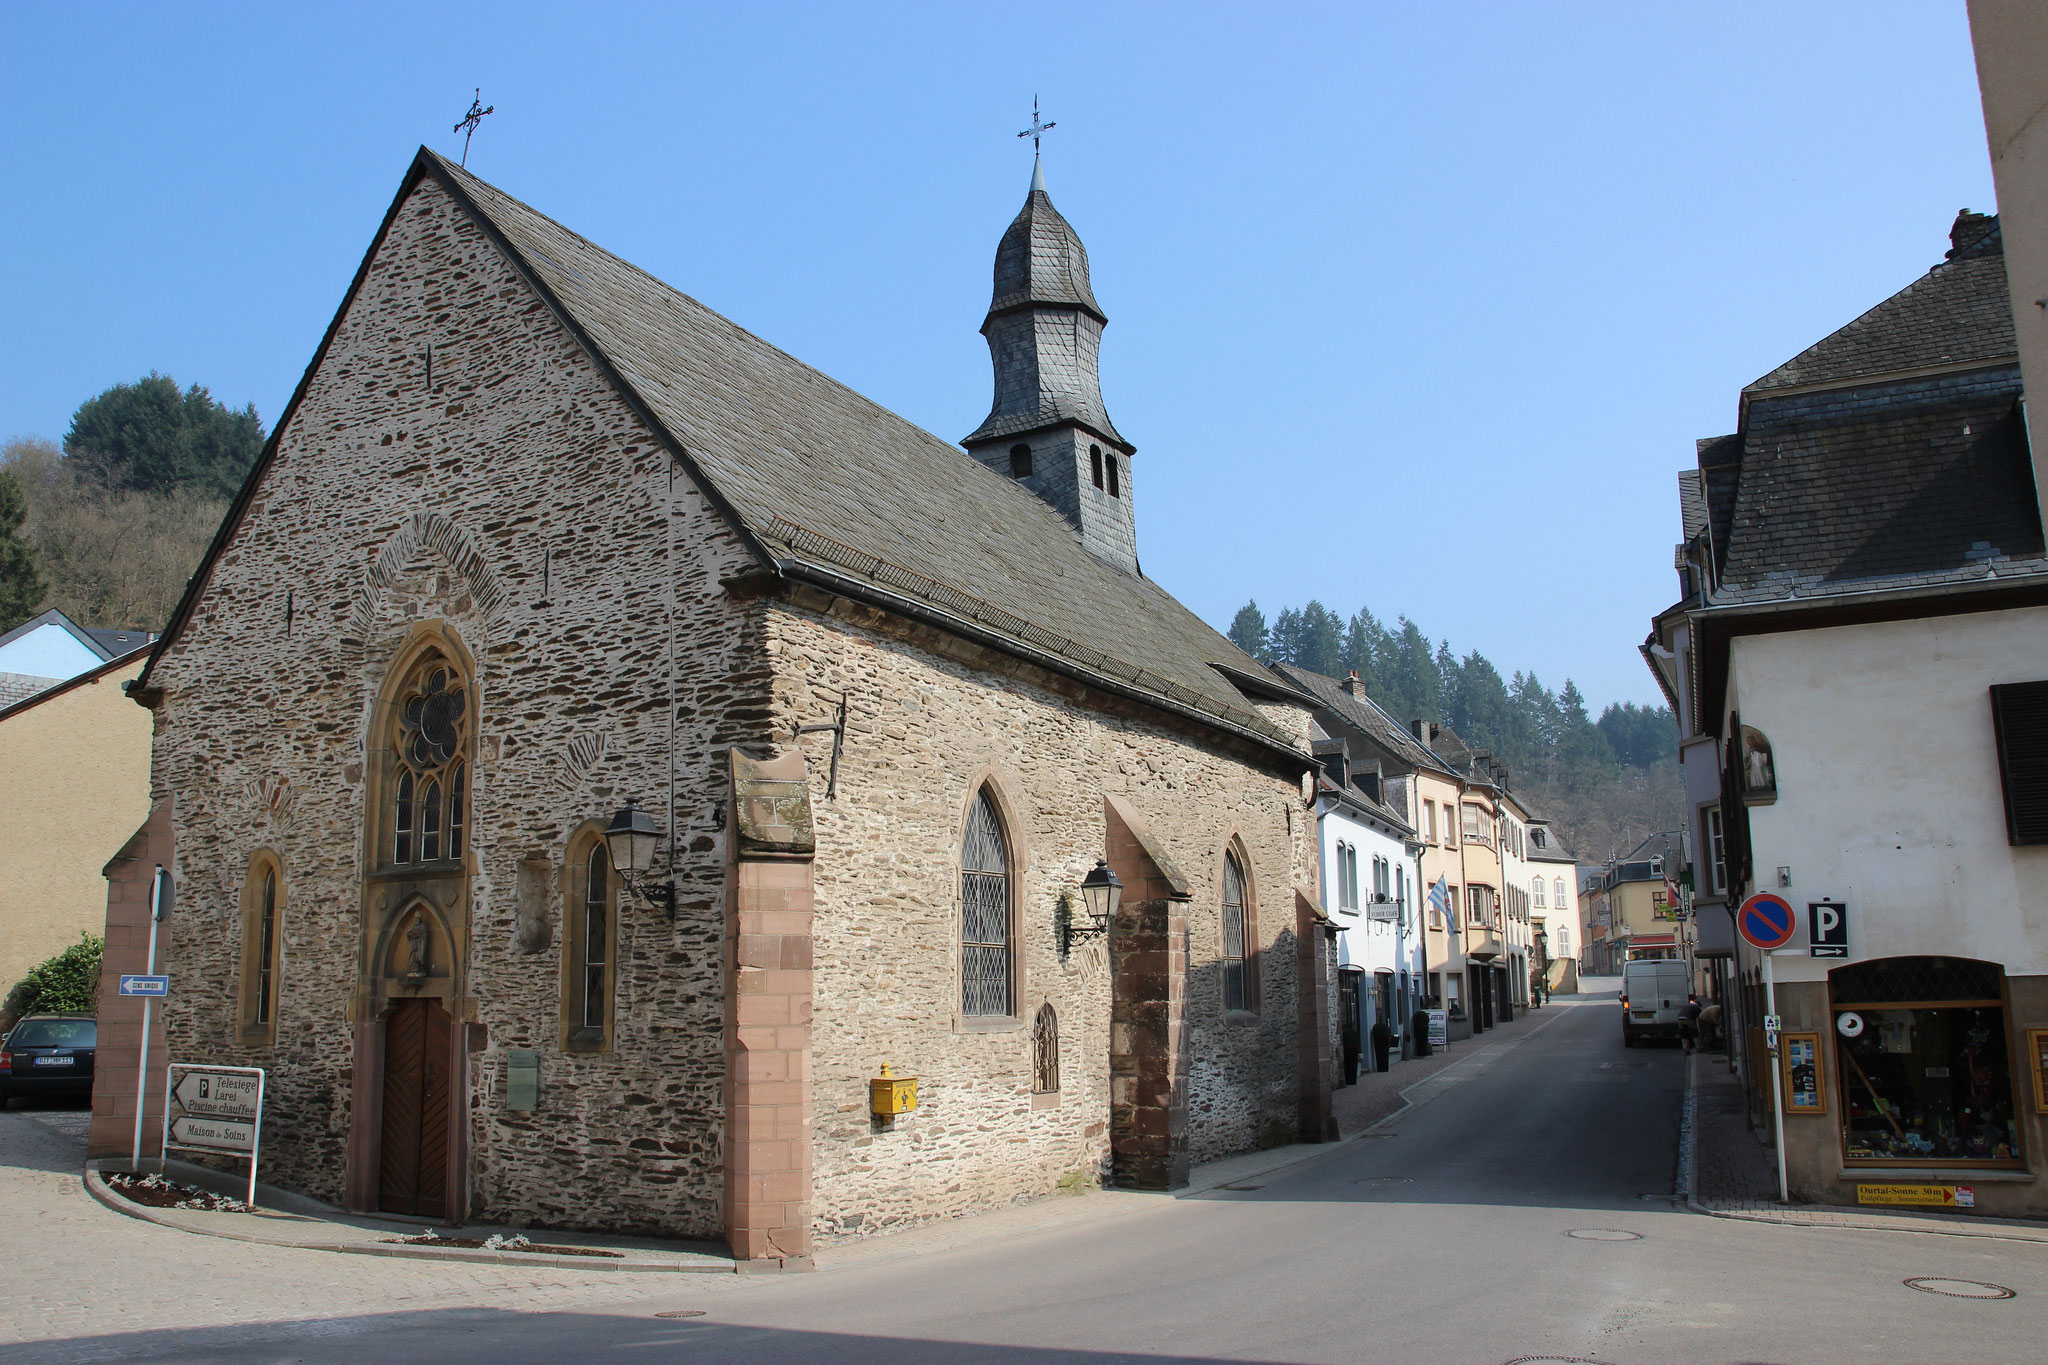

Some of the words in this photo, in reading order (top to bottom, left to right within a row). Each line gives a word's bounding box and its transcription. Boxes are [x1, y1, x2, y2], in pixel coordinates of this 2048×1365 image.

[1816, 906, 1839, 941] P
[200, 1080, 208, 1096] P
[188, 1100, 217, 1112] Piscine
[187, 1125, 215, 1137] Maison
[223, 1128, 246, 1141] Soins
[1860, 1186, 1918, 1195] Ourtal-Sonne
[1898, 1196, 1943, 1204] Sonnenstudio
